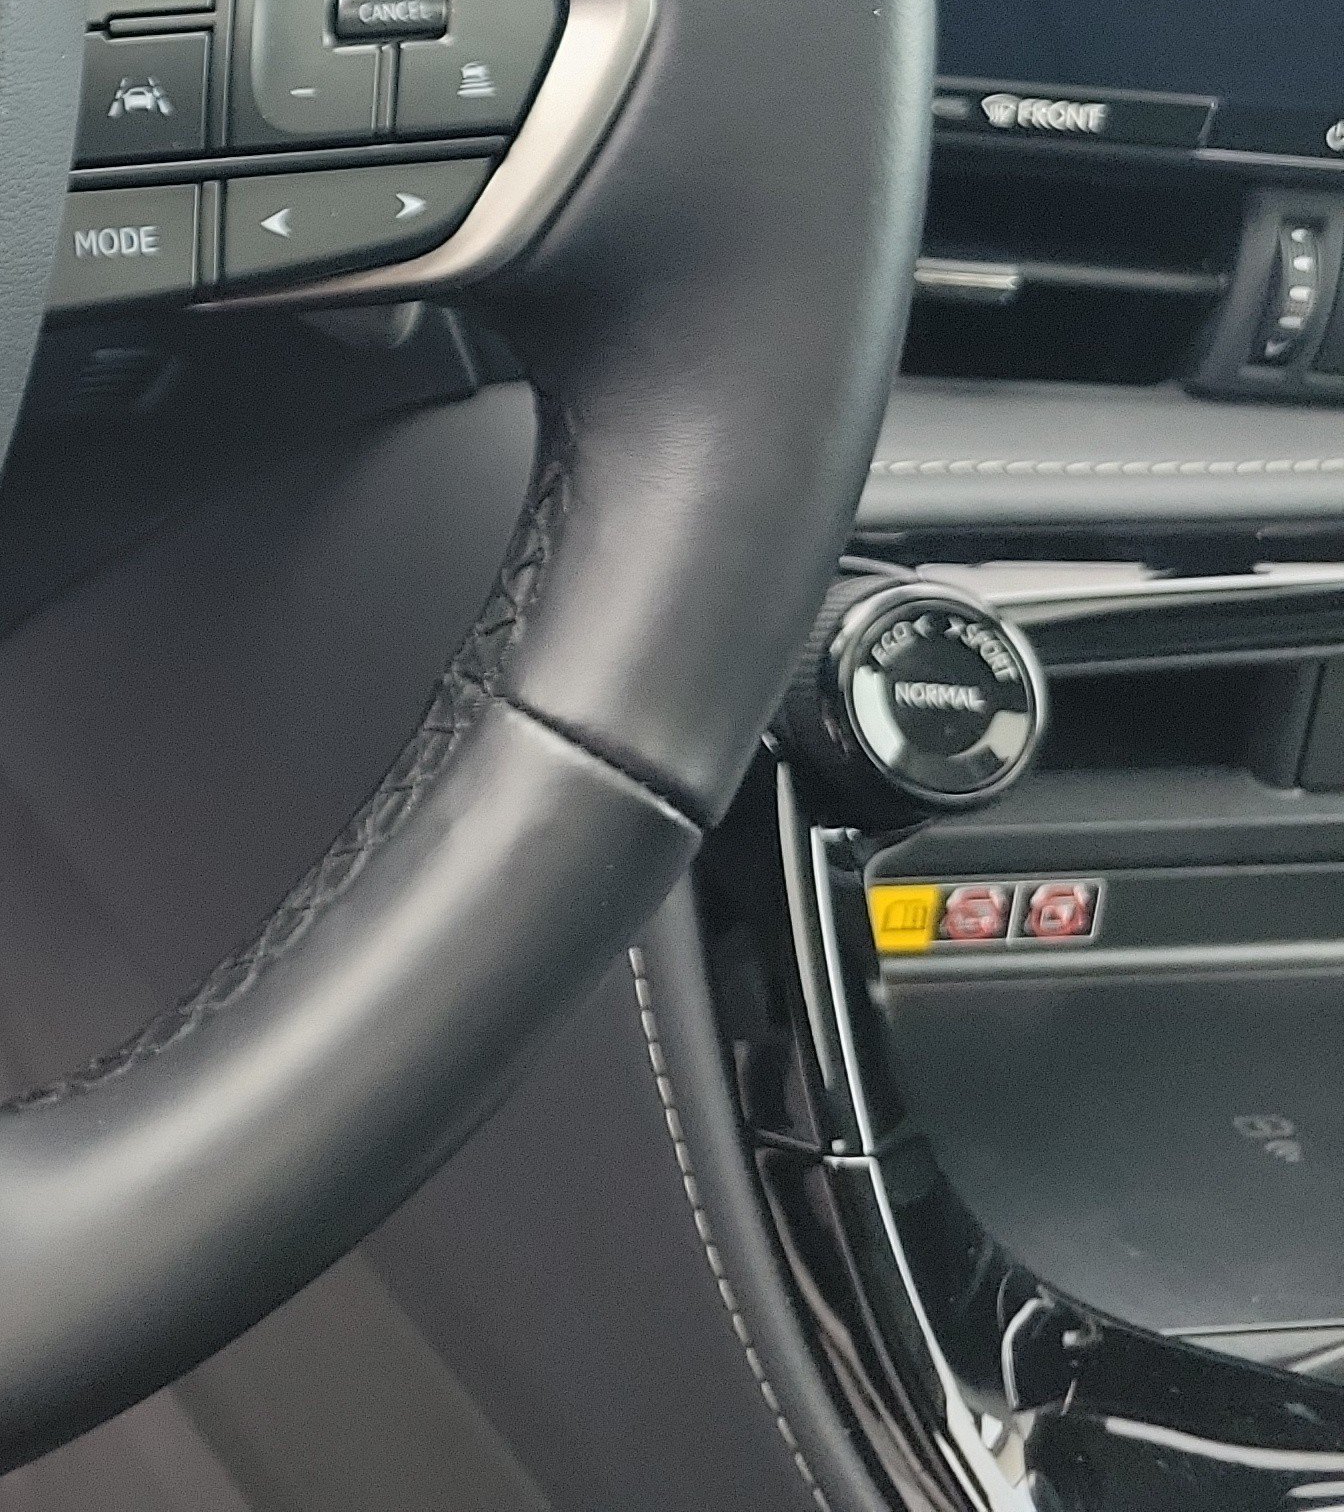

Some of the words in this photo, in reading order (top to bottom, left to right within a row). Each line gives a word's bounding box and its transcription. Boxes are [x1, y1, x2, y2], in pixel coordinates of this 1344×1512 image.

[1017, 97, 1109, 134] FRONT
[74, 226, 160, 258] MODE
[871, 621, 916, 668] ECO
[962, 622, 1020, 685] SPORT
[895, 682, 986, 714] NORMAL
